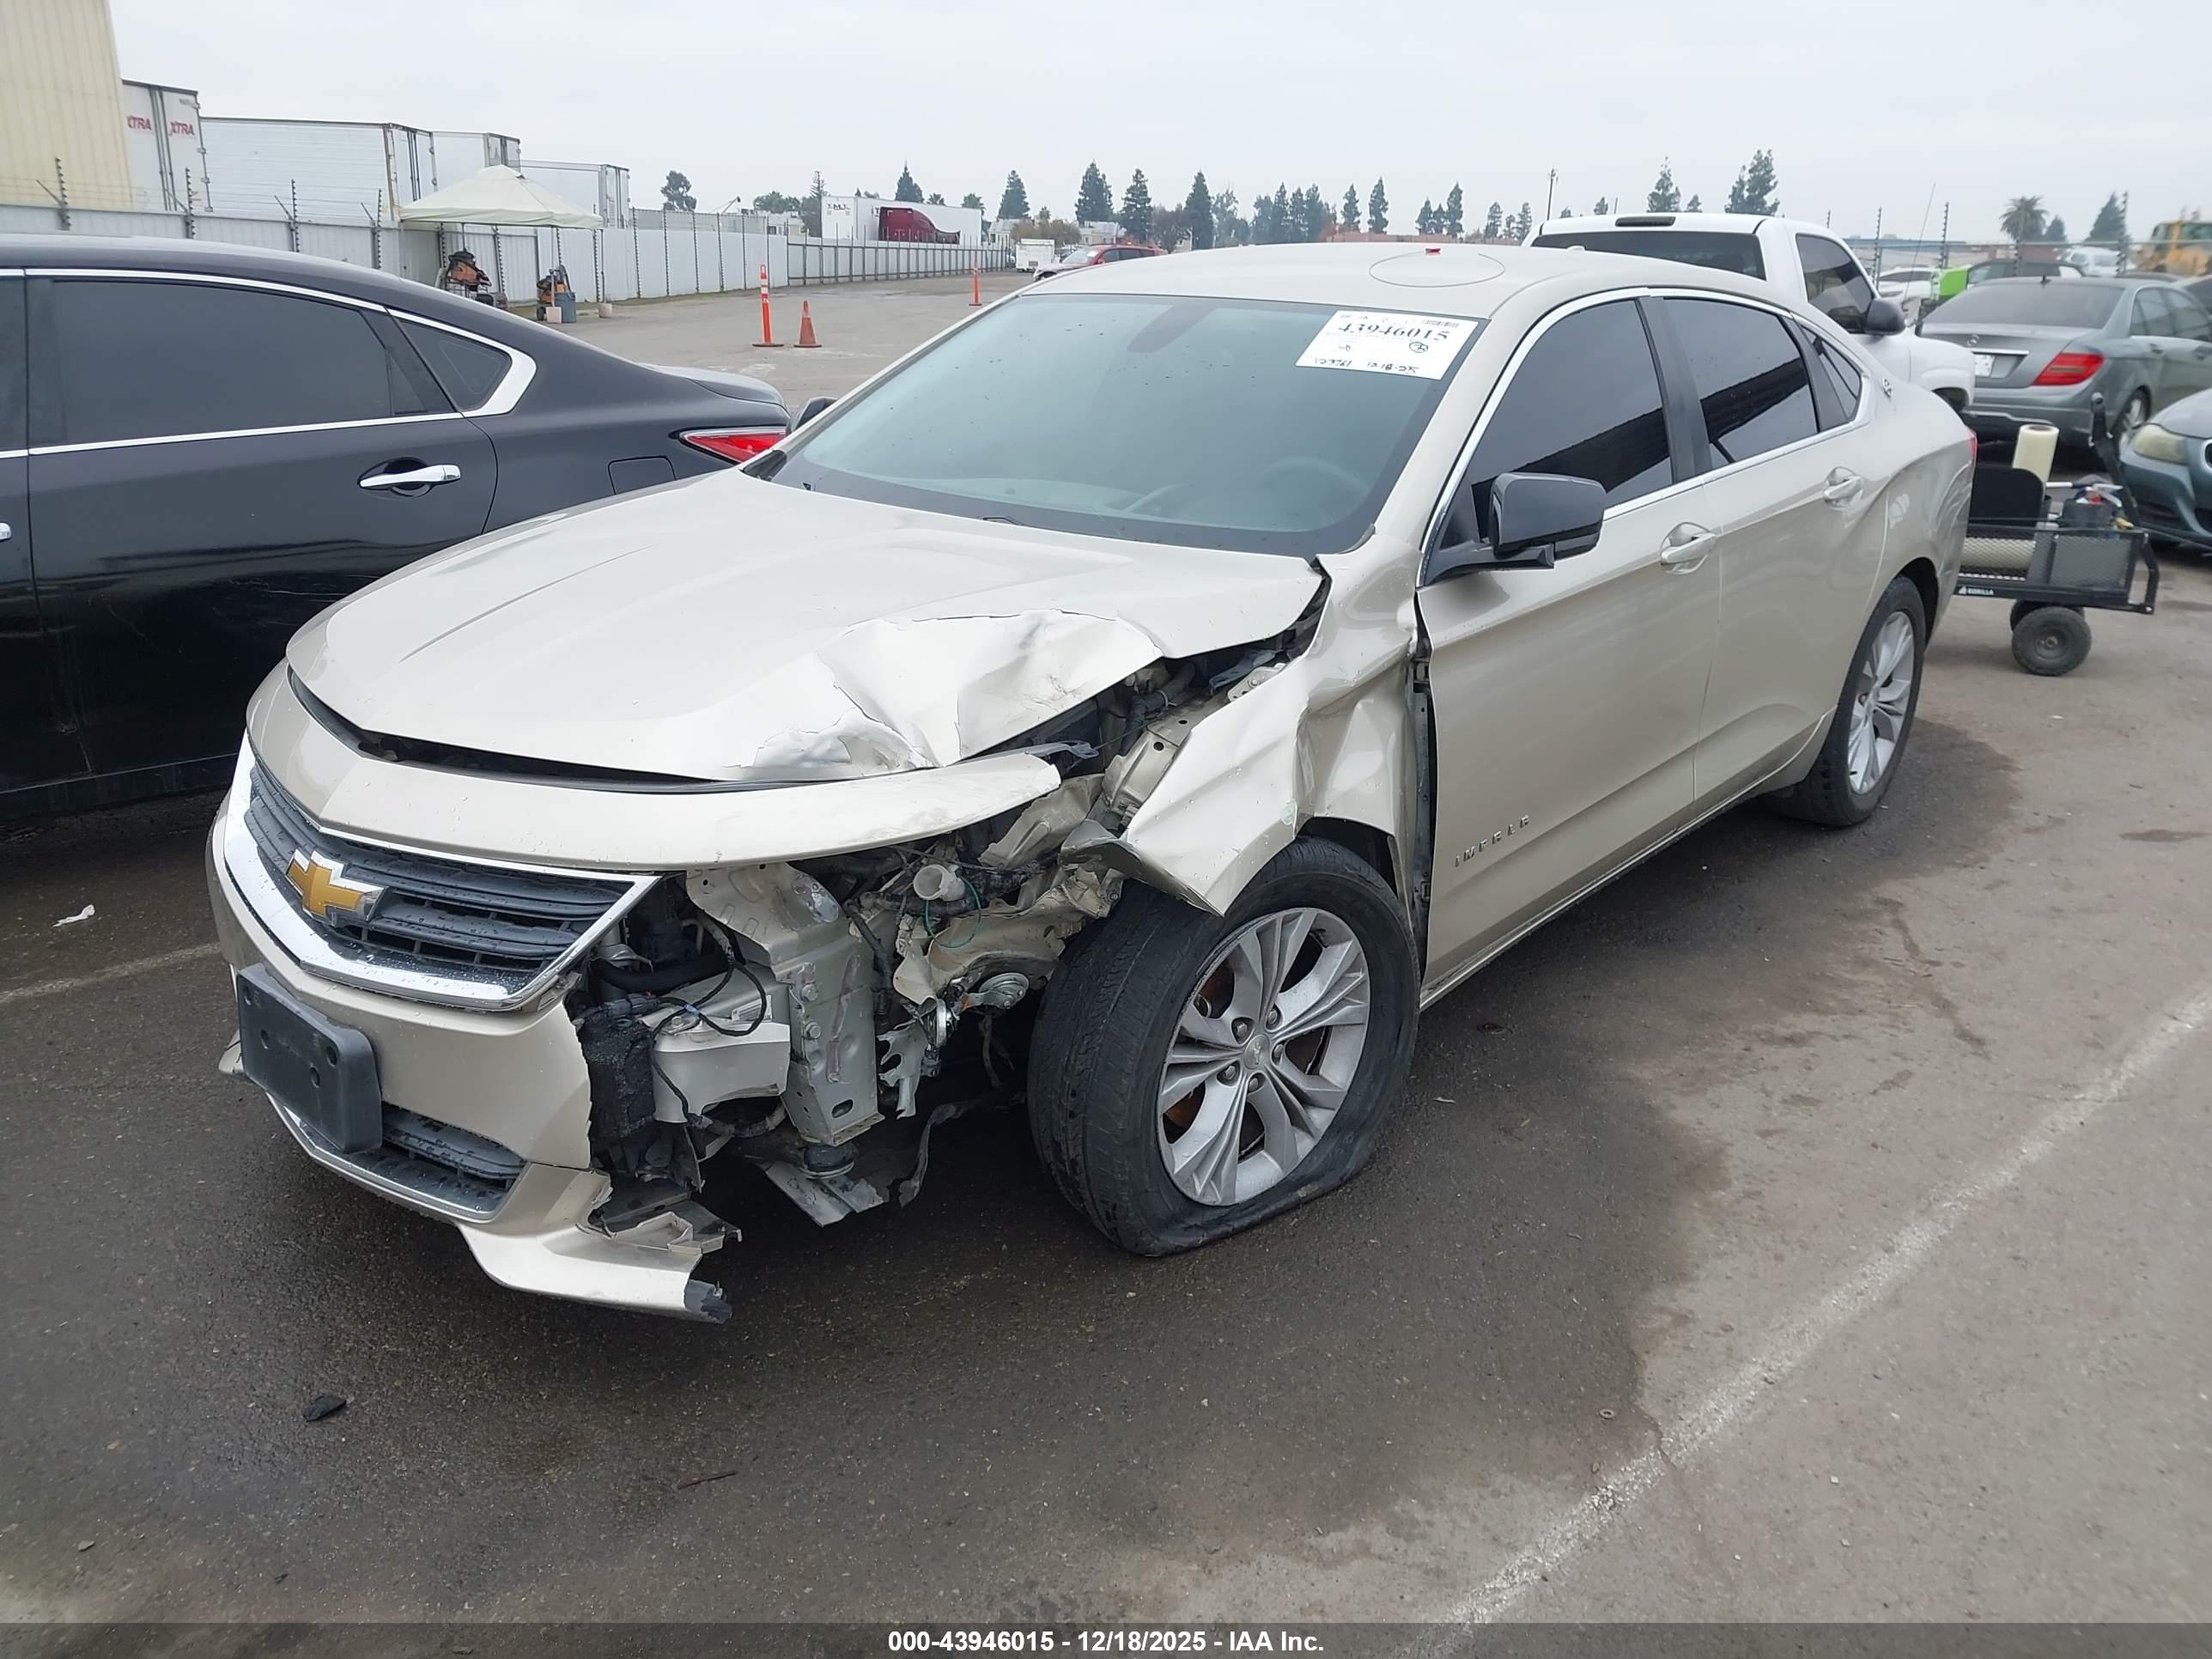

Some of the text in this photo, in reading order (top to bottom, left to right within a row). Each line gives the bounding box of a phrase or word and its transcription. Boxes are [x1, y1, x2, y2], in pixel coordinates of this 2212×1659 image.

[169, 121, 195, 136] XTRA
[1338, 323, 1450, 341] 43946015
[1454, 814, 1531, 867] IMPALA
